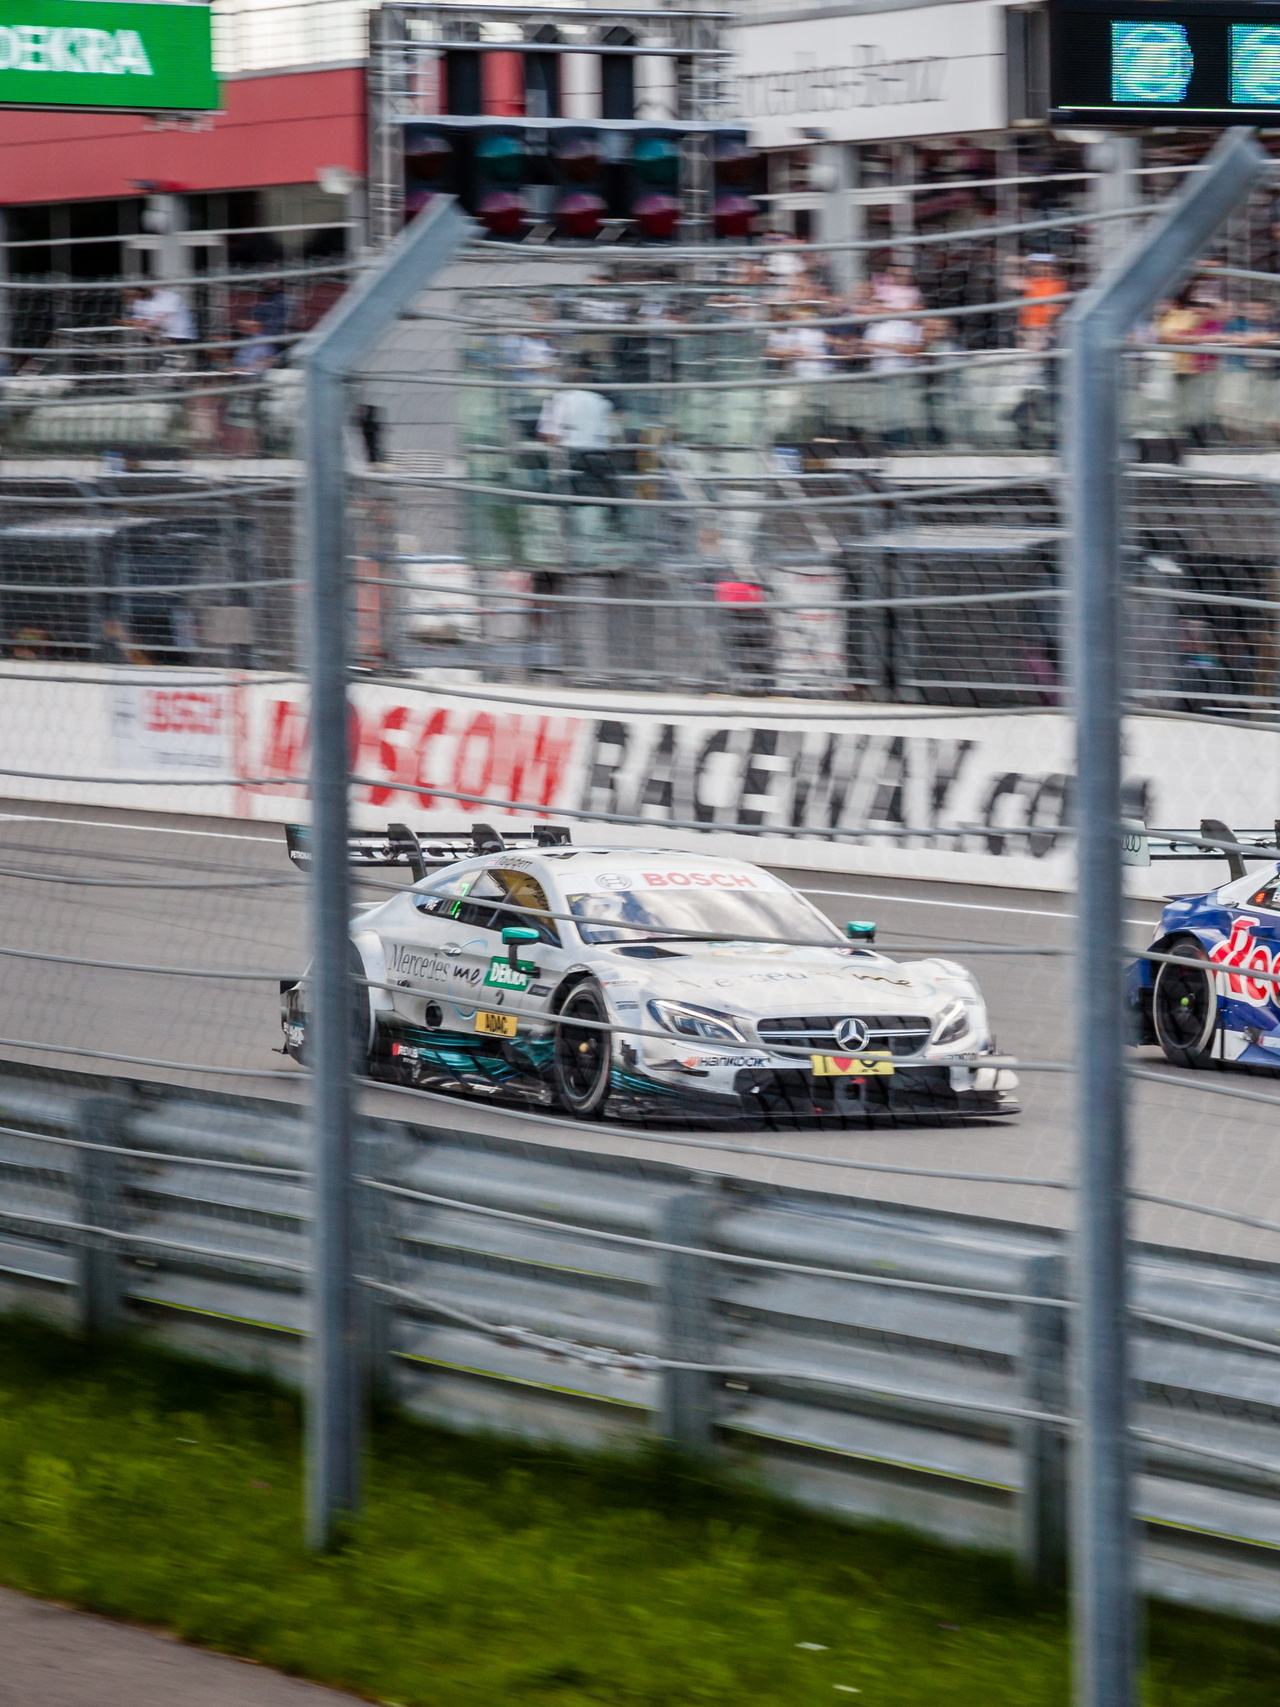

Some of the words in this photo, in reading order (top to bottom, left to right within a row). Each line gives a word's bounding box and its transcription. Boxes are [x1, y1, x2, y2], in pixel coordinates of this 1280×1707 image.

[290, 850, 312, 860] PETRONAS
[642, 872, 758, 888] BOSCH
[388, 944, 450, 982] Mercedes
[454, 965, 482, 986] me
[485, 1013, 508, 1035] ADAC
